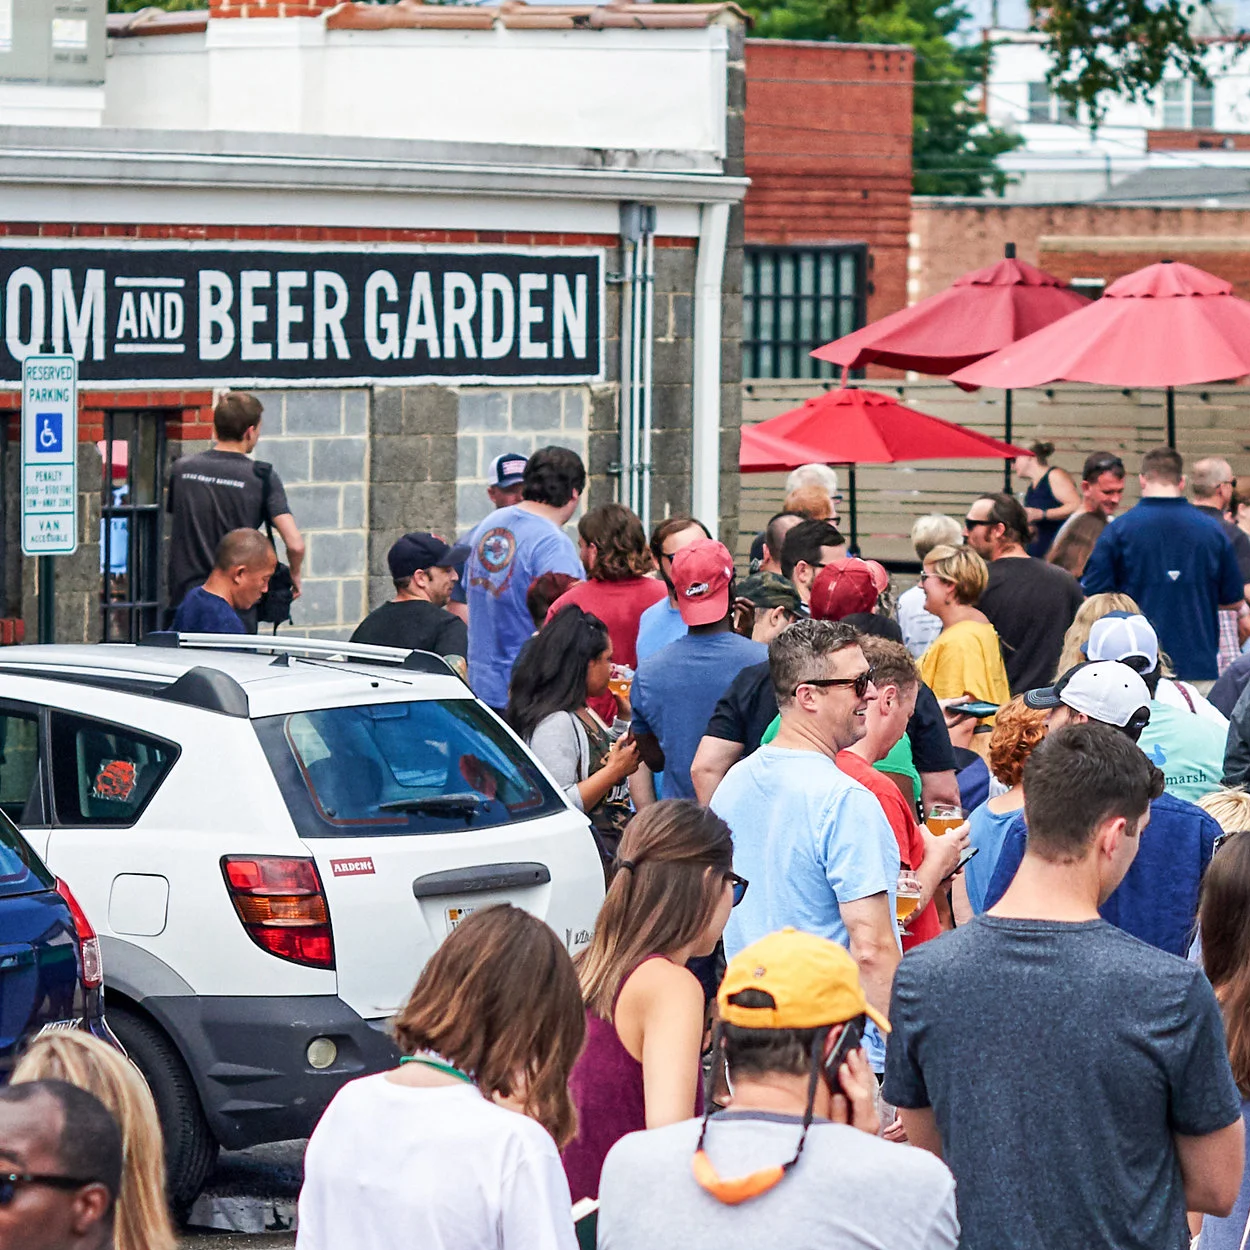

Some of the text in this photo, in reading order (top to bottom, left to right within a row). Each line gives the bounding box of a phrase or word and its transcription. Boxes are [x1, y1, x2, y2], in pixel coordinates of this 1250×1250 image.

[116, 291, 185, 339] AND
[198, 269, 352, 361] BEER
[363, 269, 589, 361] GARDEN
[27, 366, 73, 380] RESERVED
[29, 388, 70, 402] PARKING
[35, 471, 62, 481] PENALTY
[39, 521, 60, 531] VAN
[30, 533, 68, 543] ACCESSIBLE
[1166, 769, 1207, 785] marsh
